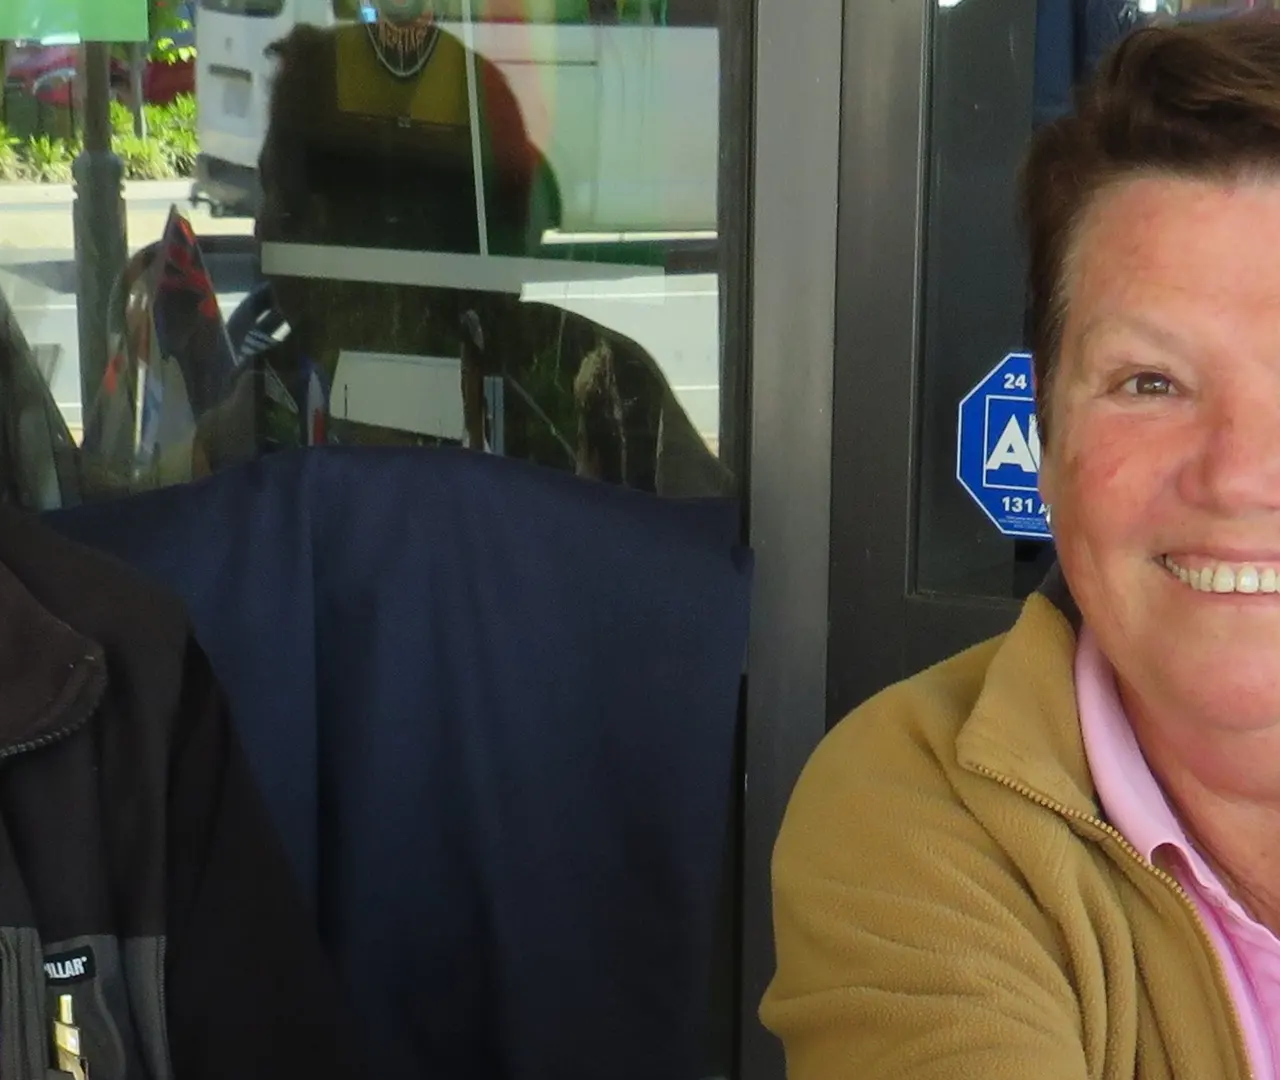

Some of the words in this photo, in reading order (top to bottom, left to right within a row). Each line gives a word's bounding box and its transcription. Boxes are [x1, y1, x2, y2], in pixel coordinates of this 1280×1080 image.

[1003, 373, 1028, 390] 24
[1001, 496, 1035, 514] 131
[43, 957, 86, 980] ILLAR
